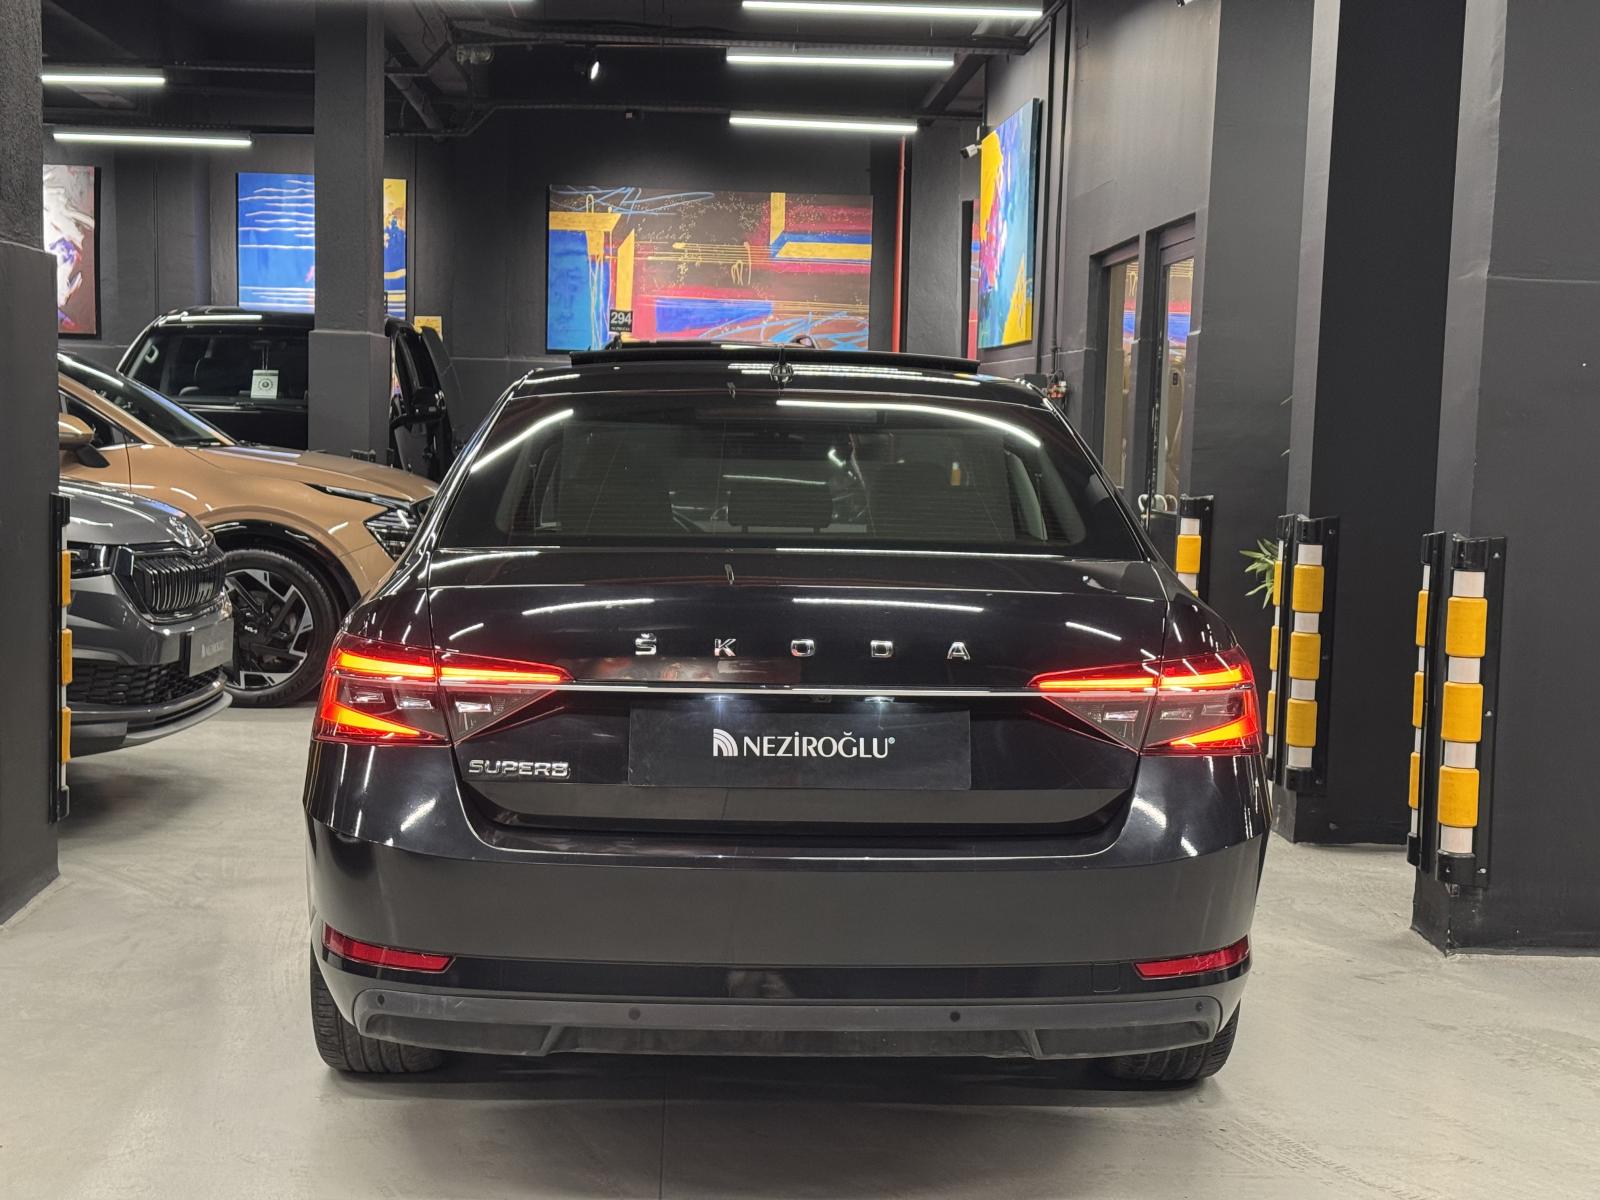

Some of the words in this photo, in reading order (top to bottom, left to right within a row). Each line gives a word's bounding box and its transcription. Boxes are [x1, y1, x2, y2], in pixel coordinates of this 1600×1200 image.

[610, 312, 632, 325] 294
[634, 632, 970, 660] ŠKODA
[468, 759, 570, 777] SUPERB
